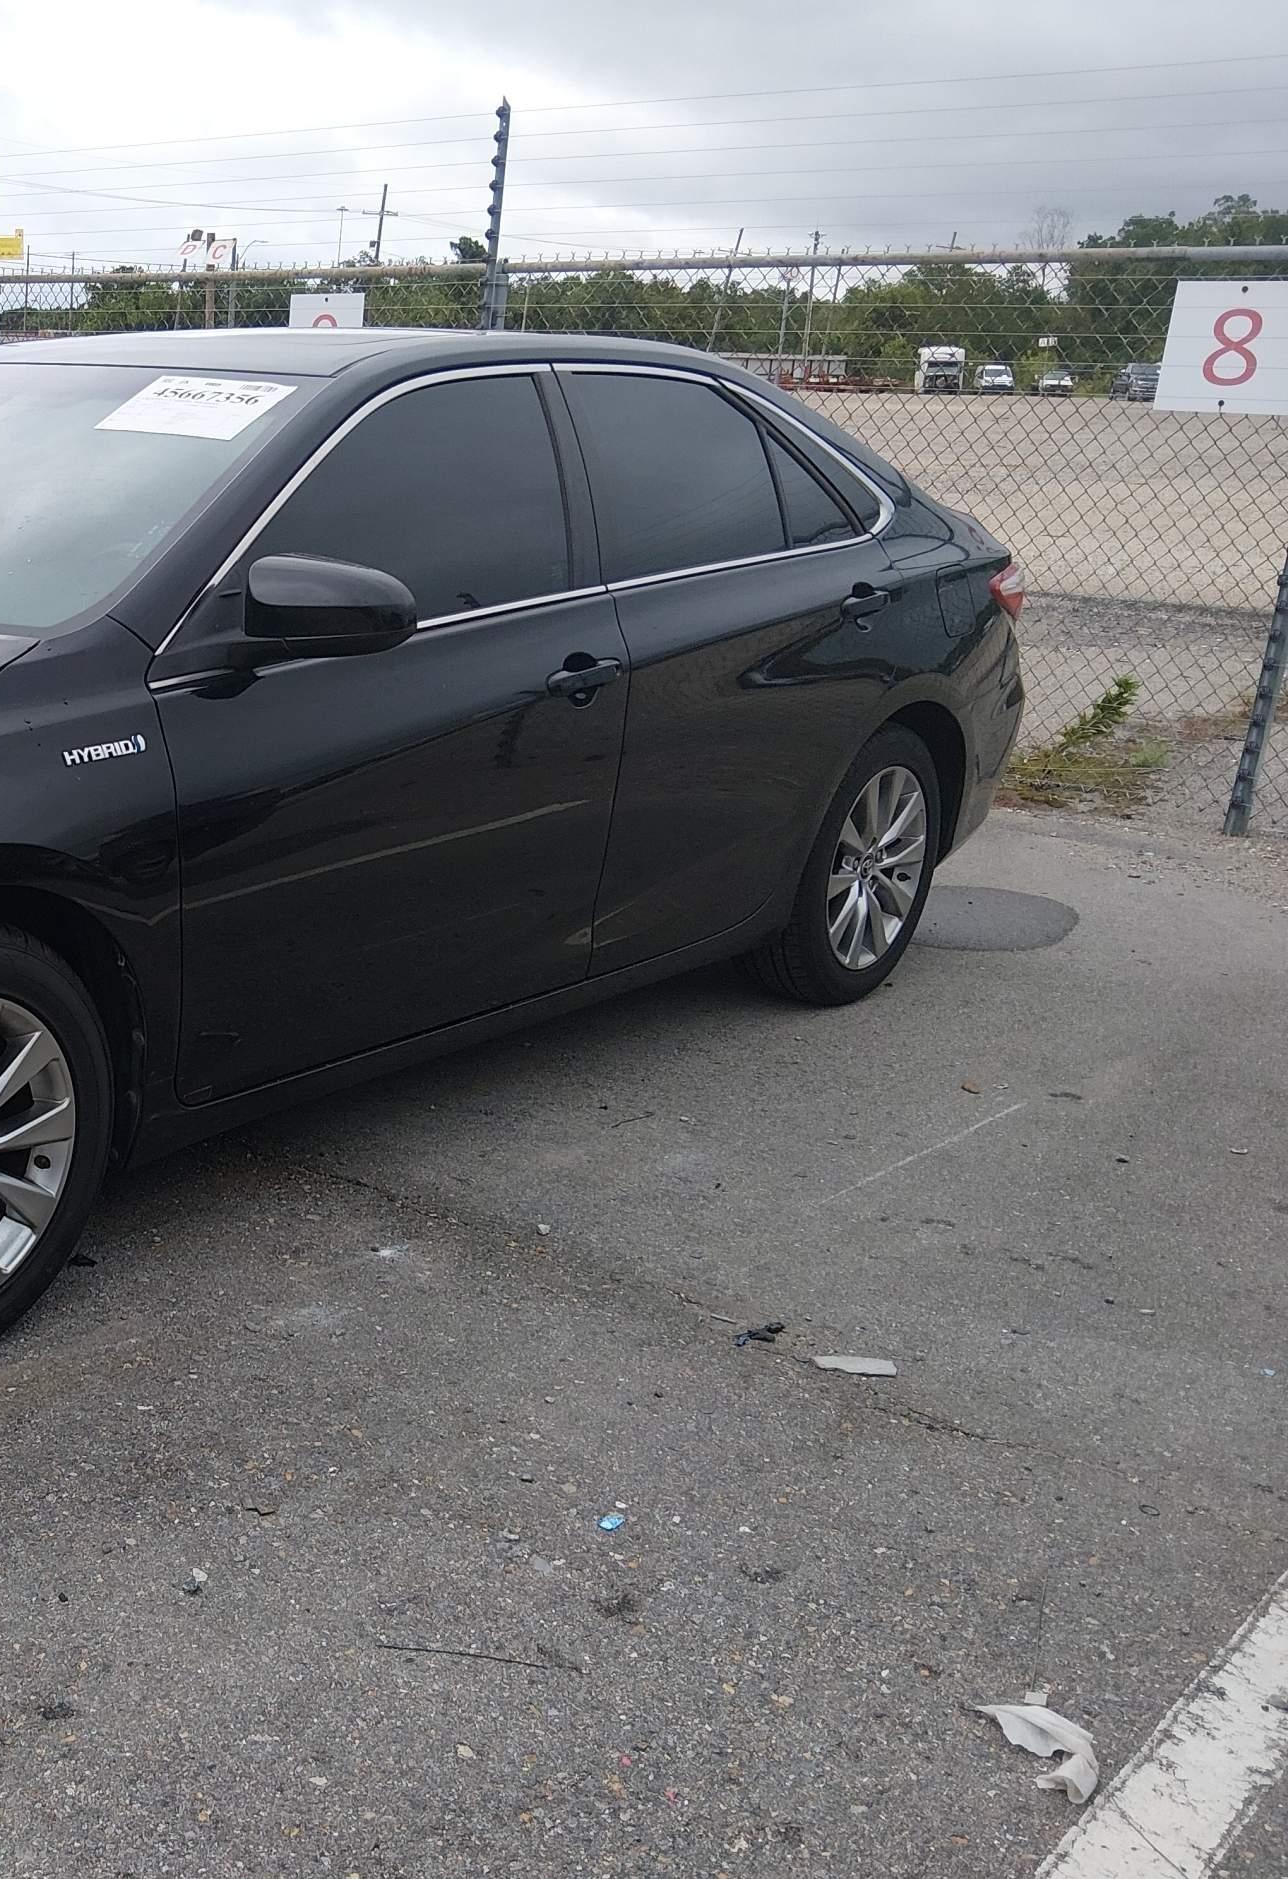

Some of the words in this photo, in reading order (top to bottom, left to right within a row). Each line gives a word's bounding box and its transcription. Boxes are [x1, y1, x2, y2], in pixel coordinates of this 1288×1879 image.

[212, 244, 227, 260] C
[1202, 308, 1263, 386] 8
[153, 387, 264, 405] 45667356
[63, 739, 137, 766] HYBRID
